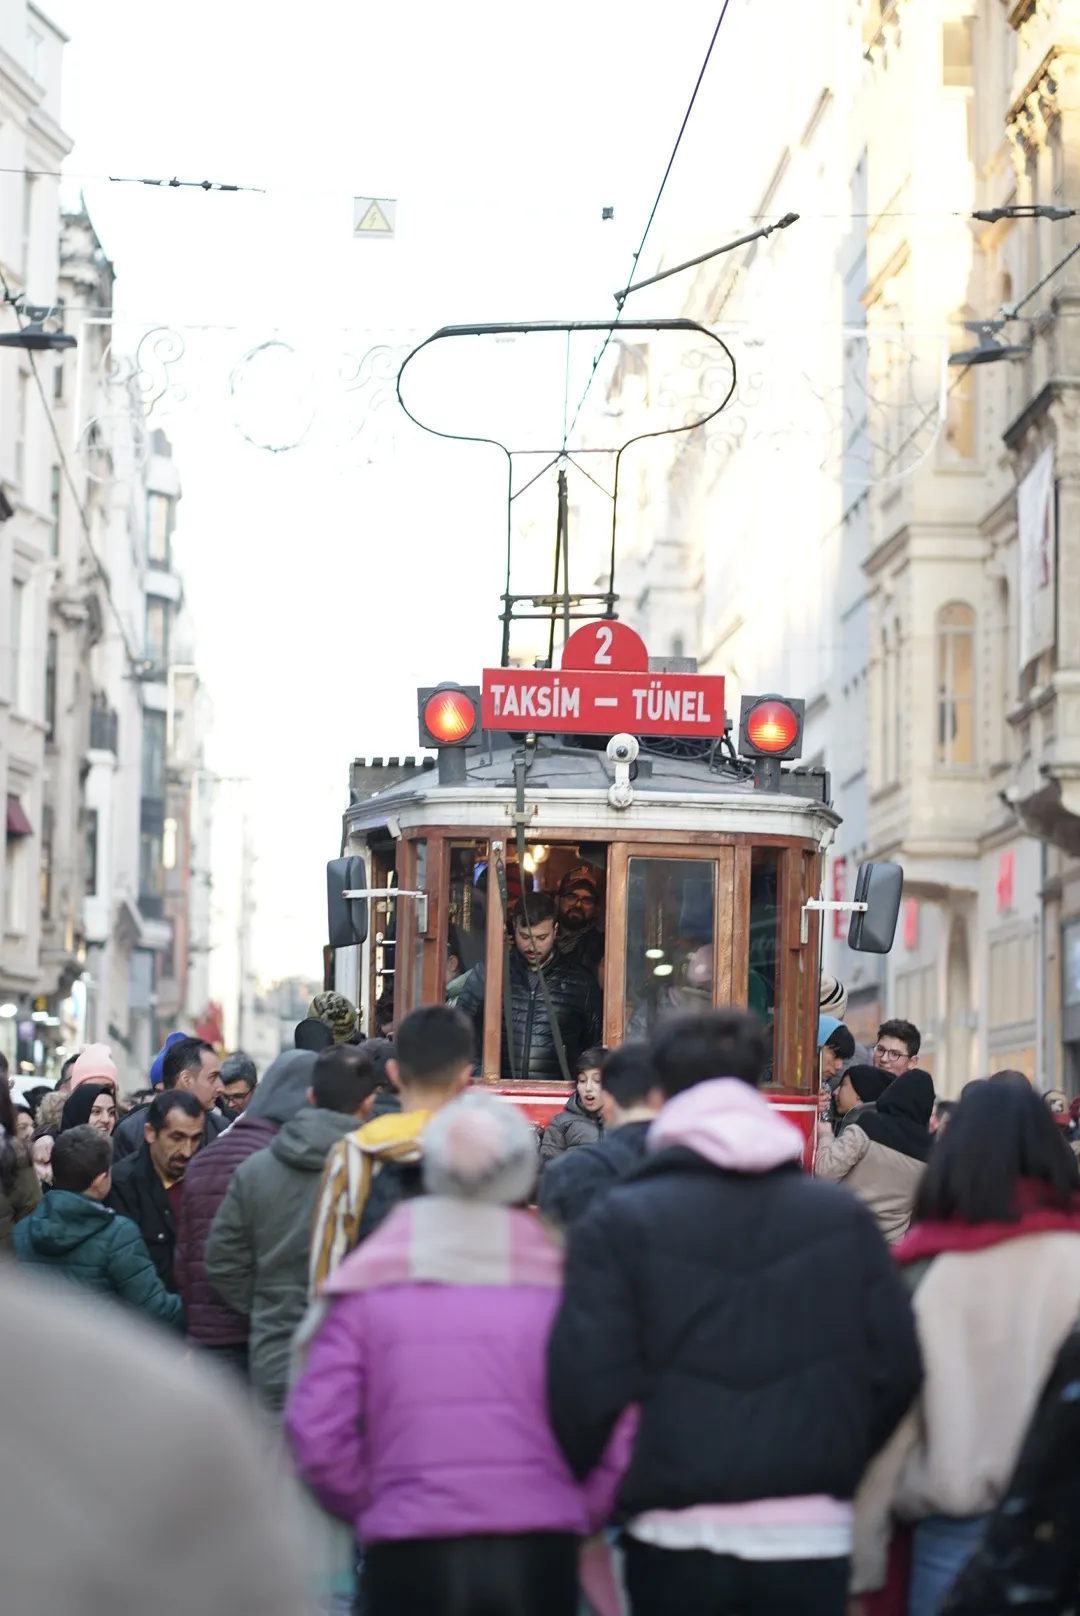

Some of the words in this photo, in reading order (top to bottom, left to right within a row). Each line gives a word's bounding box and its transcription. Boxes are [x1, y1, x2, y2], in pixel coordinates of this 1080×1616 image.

[594, 626, 613, 665] 2
[490, 678, 580, 718] TAKSİM
[632, 681, 711, 722] TÜNEL
